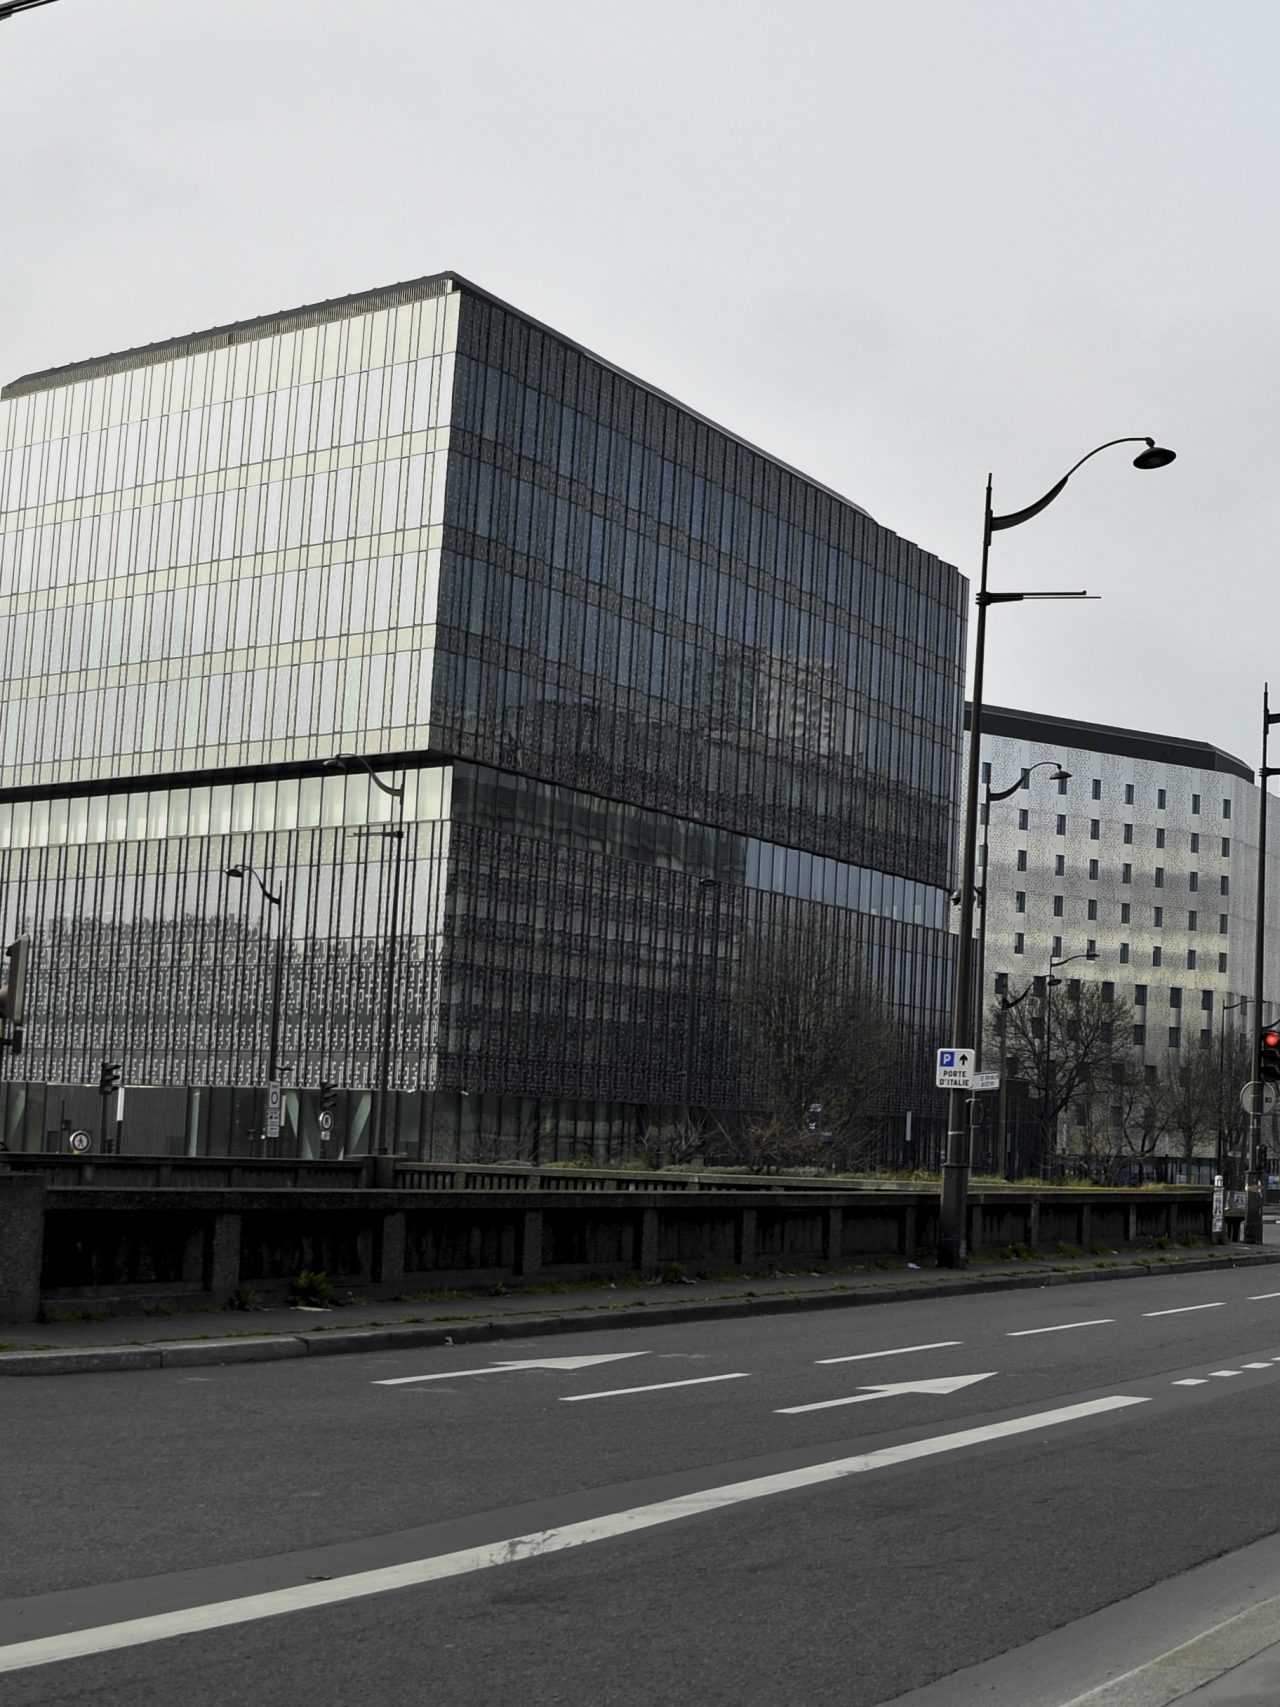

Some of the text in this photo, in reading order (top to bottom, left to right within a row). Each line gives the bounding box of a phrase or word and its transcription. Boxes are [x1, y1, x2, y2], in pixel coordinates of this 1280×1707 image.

[942, 1053, 952, 1066] P
[943, 1070, 967, 1078] PORTE
[939, 1078, 971, 1087] D'ITALIE
